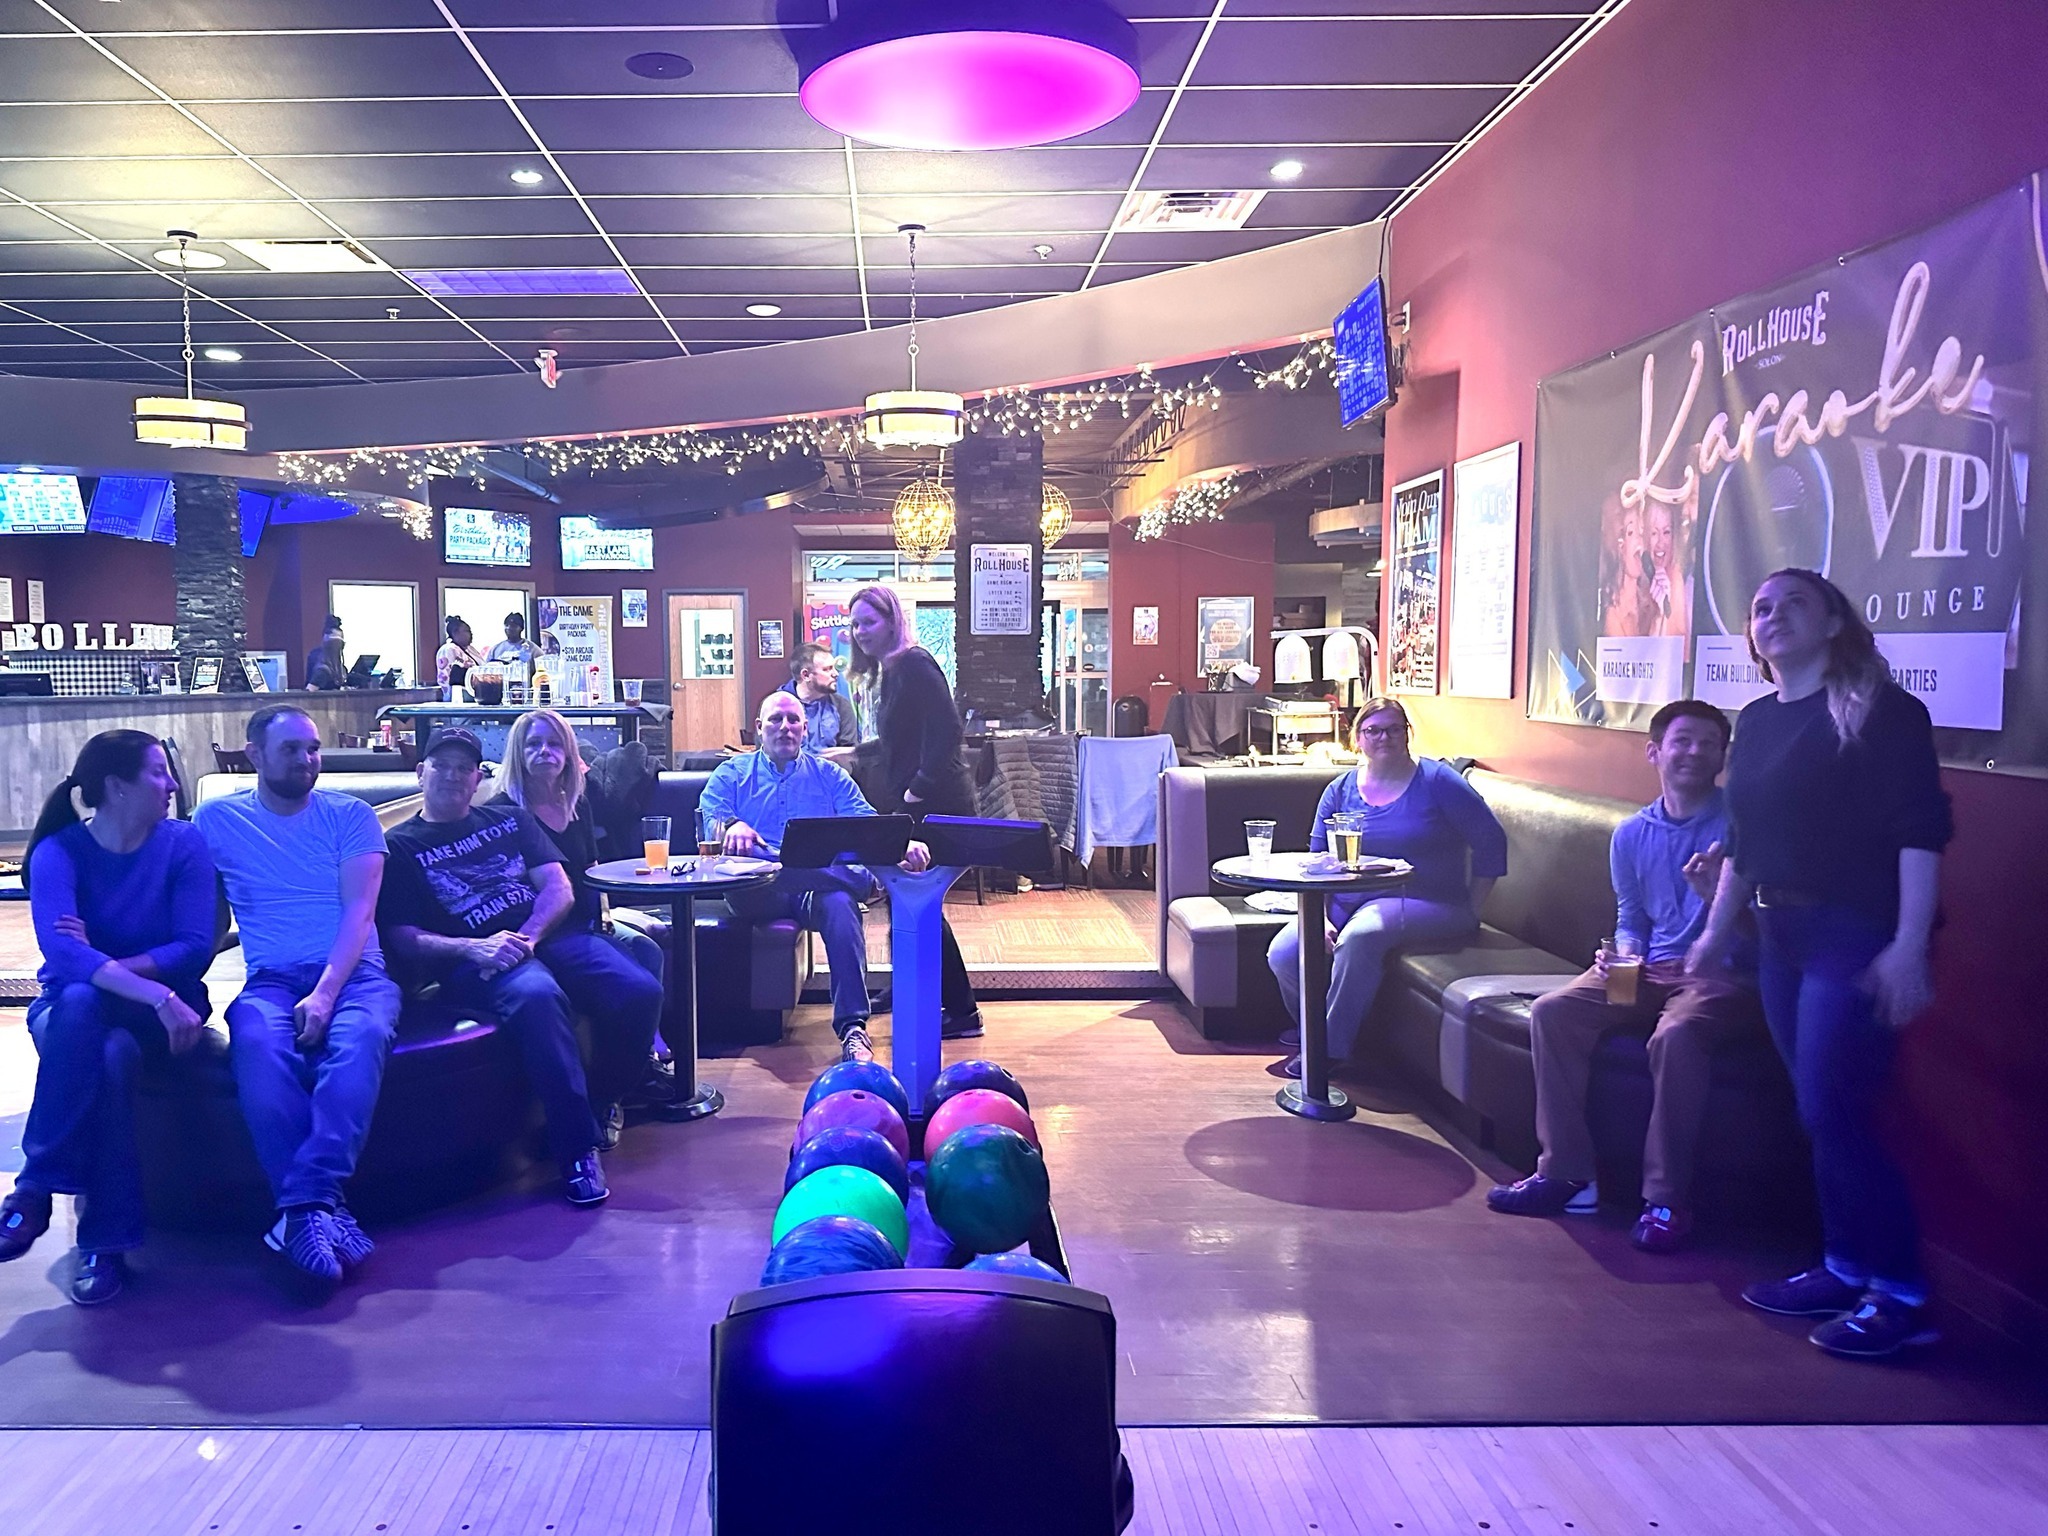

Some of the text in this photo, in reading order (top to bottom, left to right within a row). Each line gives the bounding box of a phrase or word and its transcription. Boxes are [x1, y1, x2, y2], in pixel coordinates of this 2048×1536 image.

[1721, 290, 1830, 378] ROLLHOUSE
[1620, 261, 1985, 518] Karaoke
[1851, 435, 1990, 561] VIP
[449, 535, 491, 546] PARTY PACKAGES
[974, 557, 1030, 573] ROLLHOUSE
[558, 605, 594, 617] THE GAME
[1865, 586, 1985, 623] OUNGE
[578, 654, 593, 662] CARD
[1603, 662, 1654, 680] KARAOKE NIGHTS
[1706, 664, 1729, 682] TEAM
[415, 844, 457, 868] TAKE
[453, 833, 483, 857] HIM
[478, 826, 502, 842] TO
[463, 896, 510, 929] TRAIN
